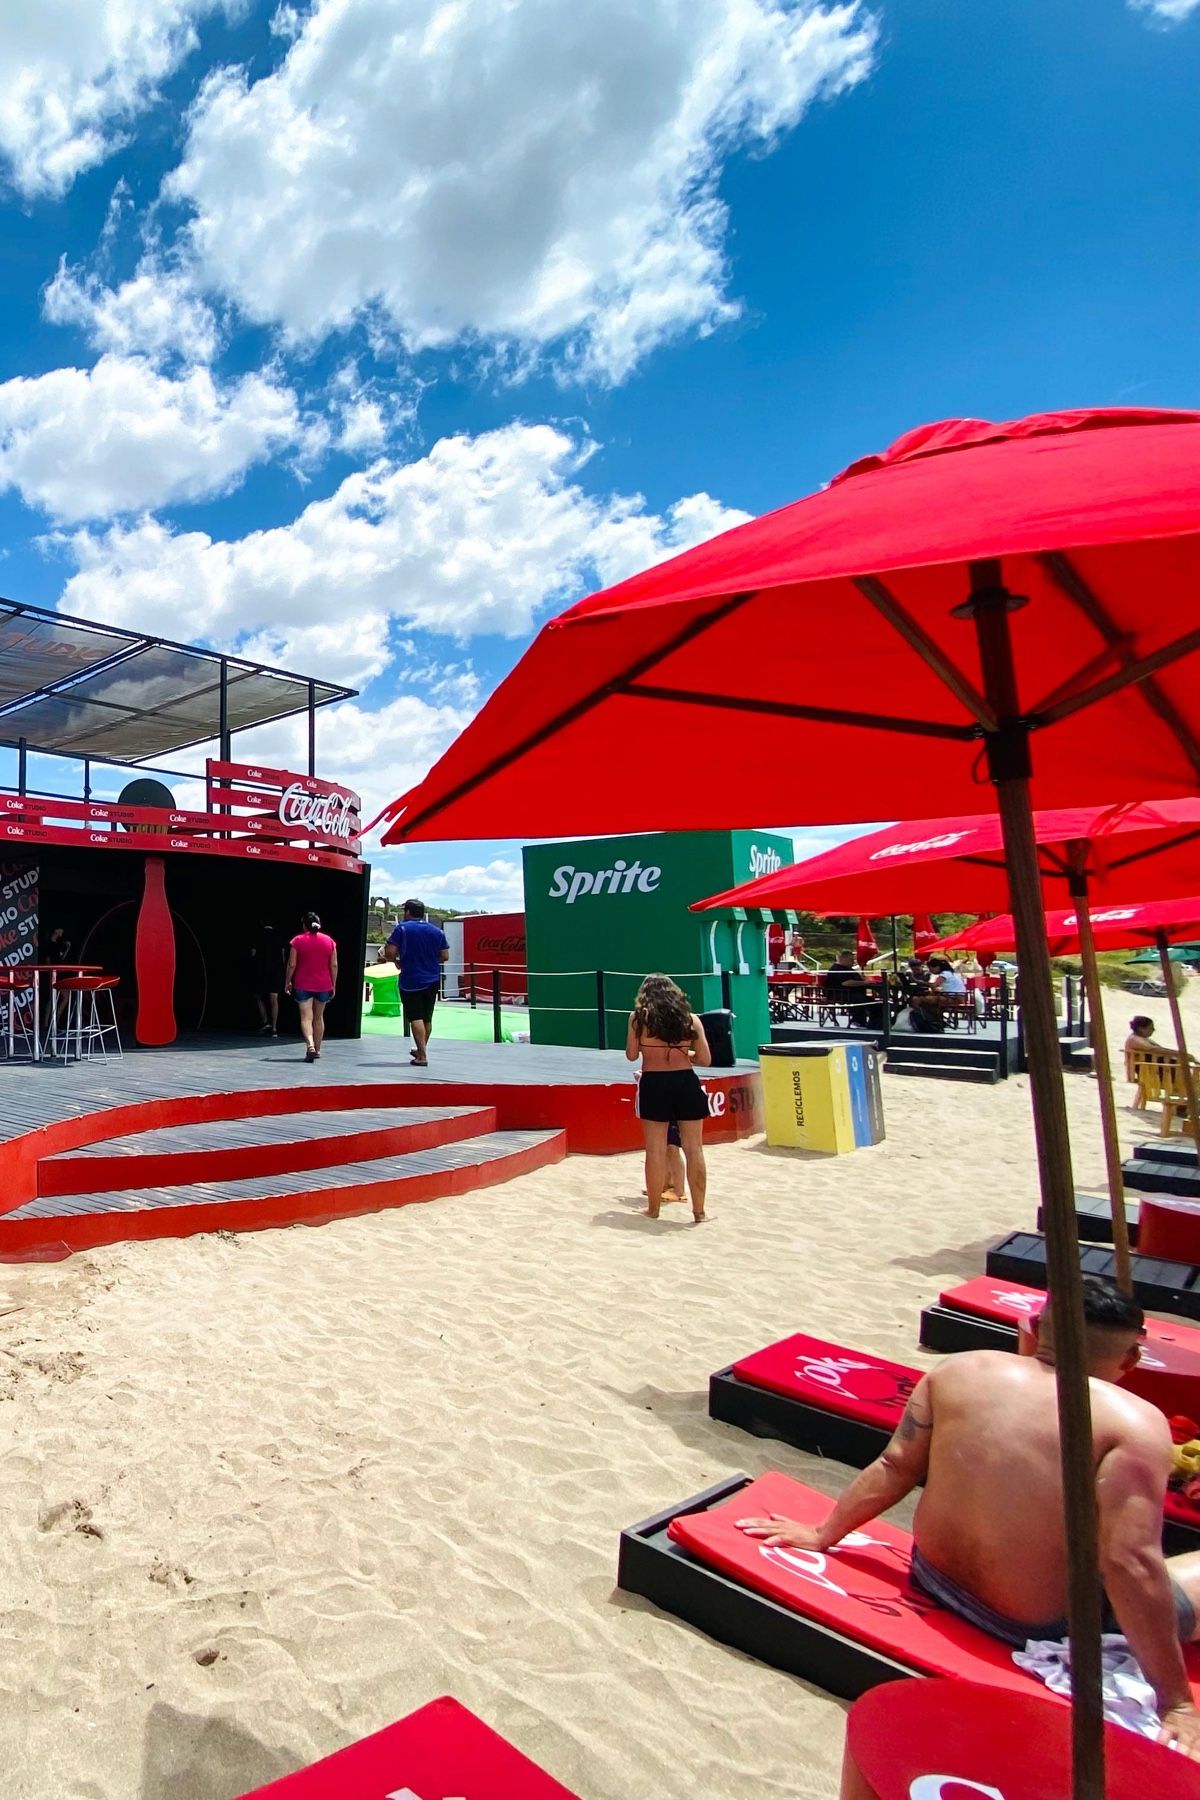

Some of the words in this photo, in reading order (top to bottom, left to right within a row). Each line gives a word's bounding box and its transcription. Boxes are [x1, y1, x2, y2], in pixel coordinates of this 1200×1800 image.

[247, 769, 262, 778] Coke
[6, 800, 24, 810] Coke
[90, 808, 109, 817] Coke
[279, 782, 352, 839] Coca-Cola
[169, 814, 187, 823] Coke
[7, 826, 24, 836] Coke
[90, 834, 108, 843] Coke
[170, 839, 188, 848] Coke
[749, 845, 781, 879] Sprite
[2, 867, 39, 900] STUD
[549, 860, 661, 904] Sprite
[792, 1070, 805, 1127] RECICLEMOS
